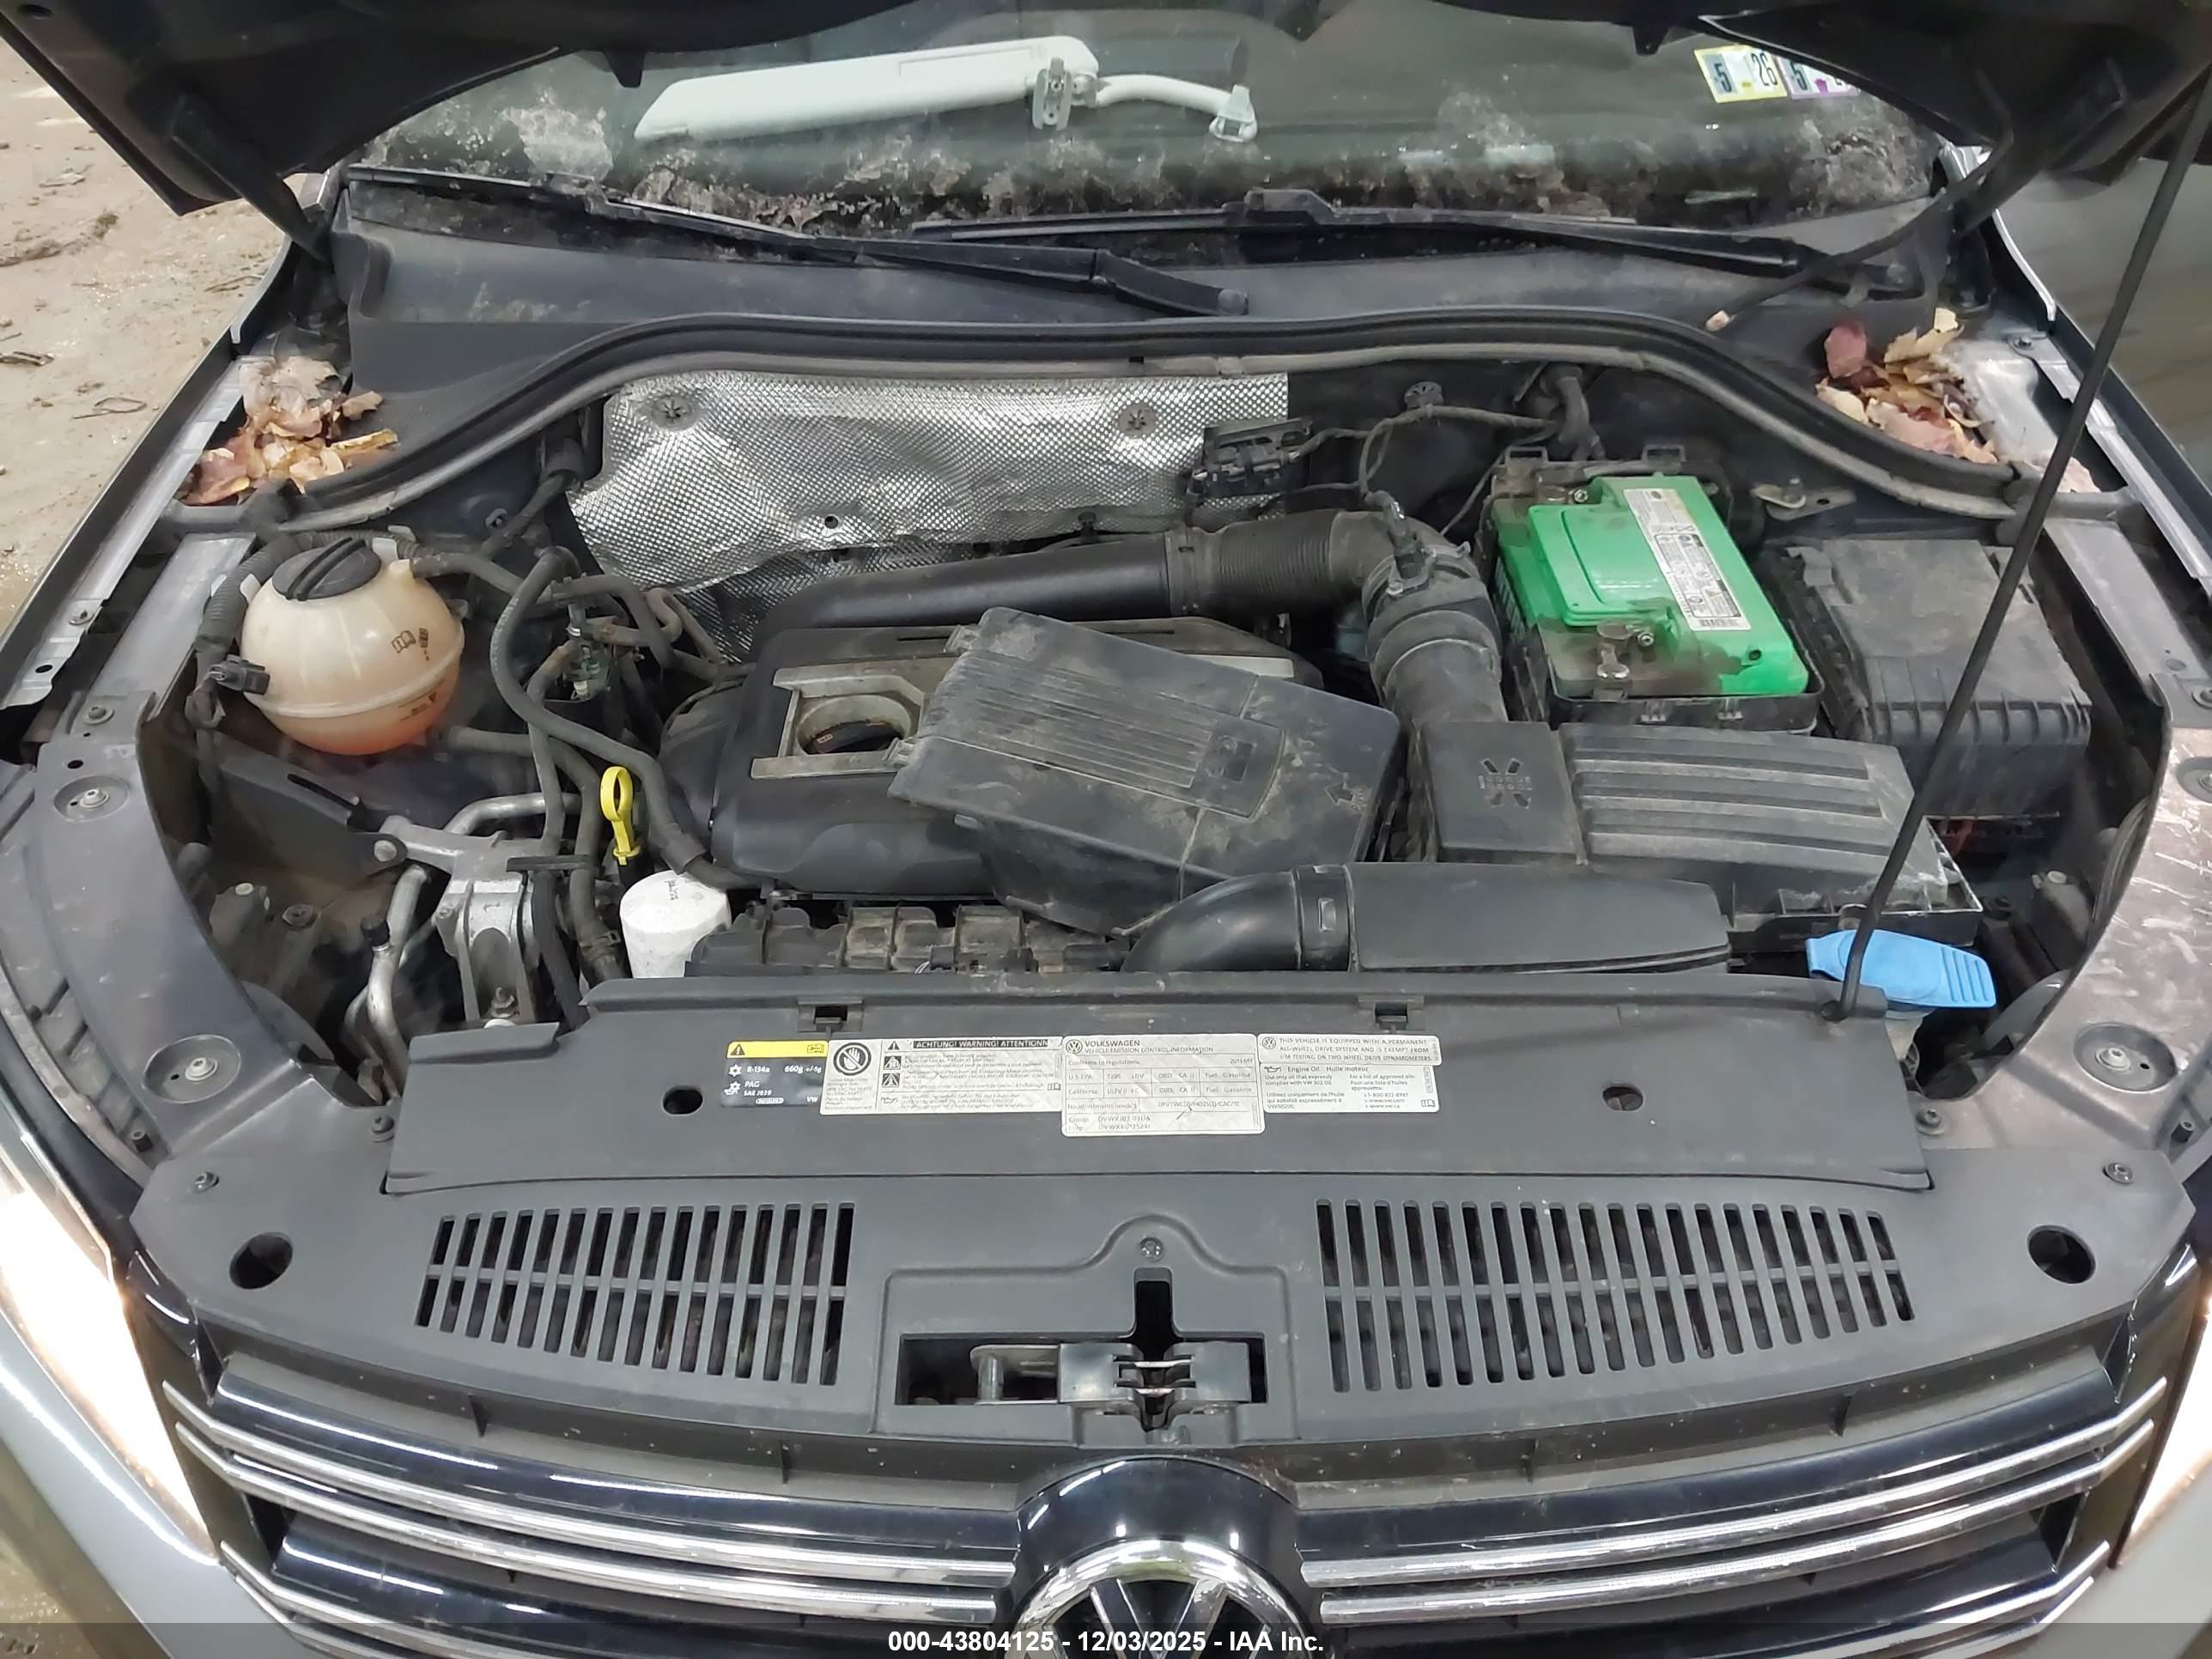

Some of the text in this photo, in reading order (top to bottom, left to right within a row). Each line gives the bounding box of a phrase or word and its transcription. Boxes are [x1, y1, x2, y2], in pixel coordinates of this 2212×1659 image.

[1713, 63, 1732, 92] 5
[1751, 52, 1778, 86] 26
[784, 1065, 804, 1073] 660g
